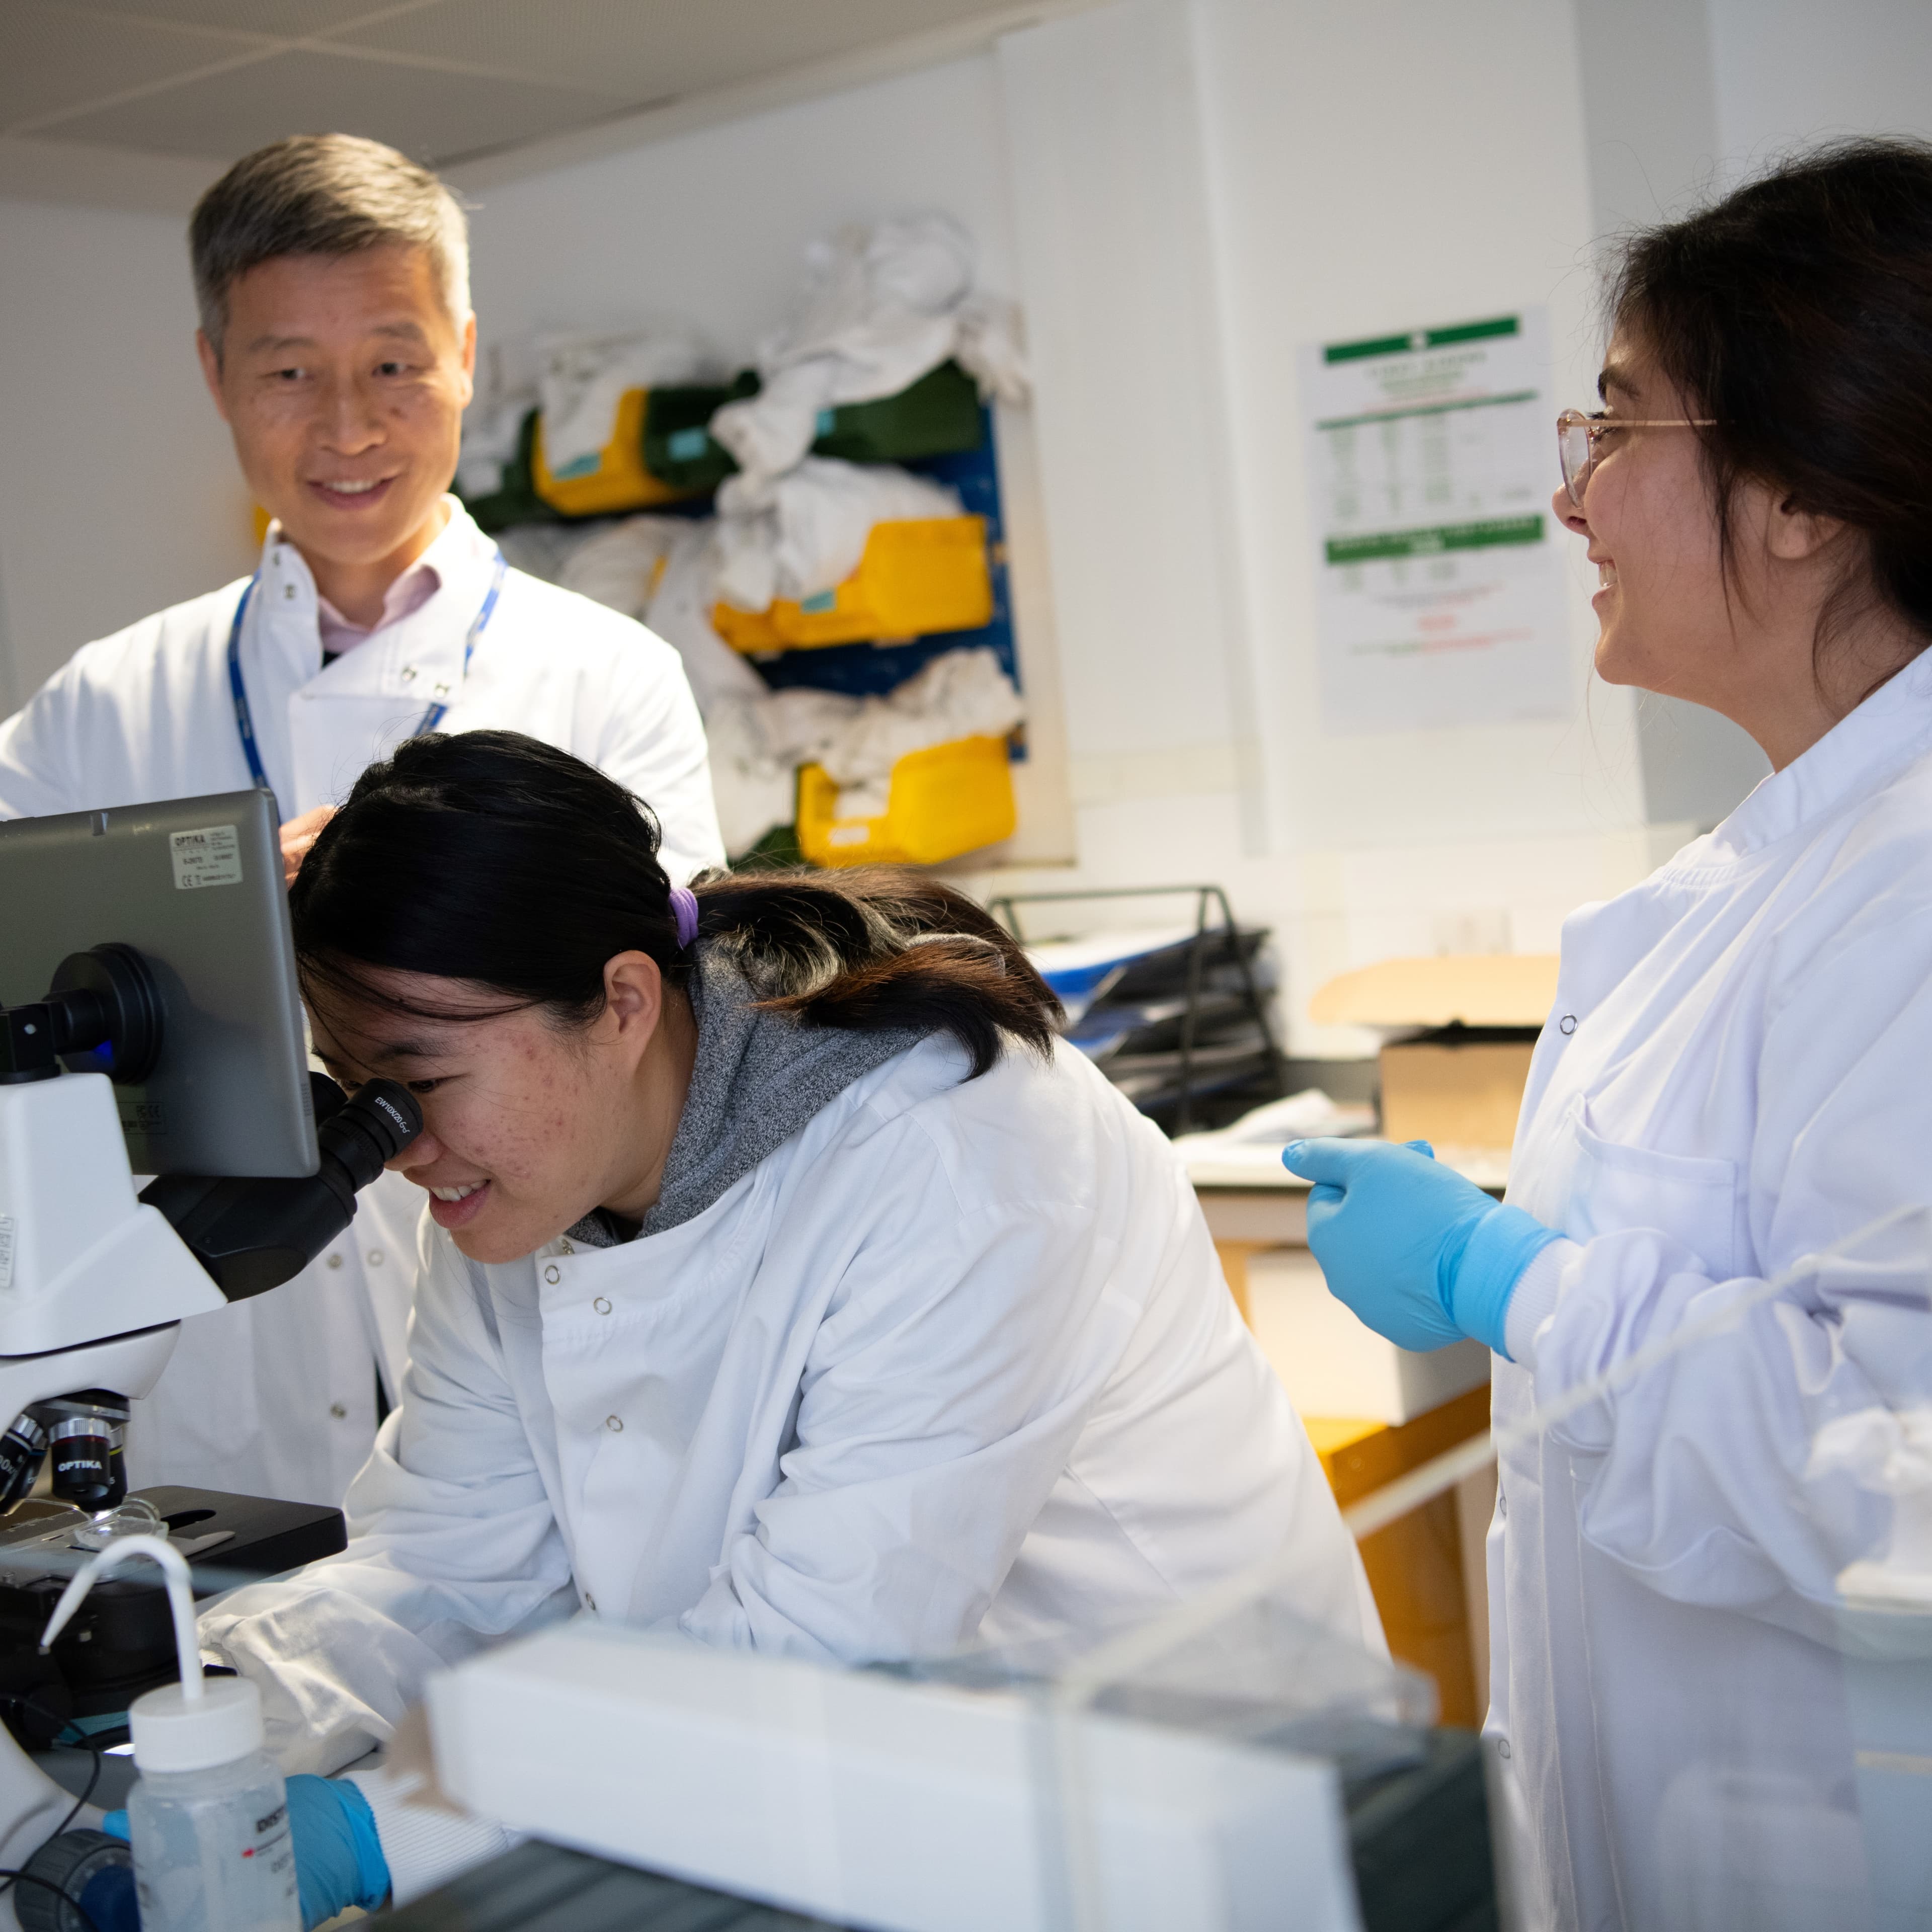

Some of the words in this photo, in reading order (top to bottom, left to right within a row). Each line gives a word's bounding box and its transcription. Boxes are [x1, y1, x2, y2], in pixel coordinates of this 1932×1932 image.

[175, 835, 206, 846] OPTIKA
[374, 1097, 403, 1123] EW10X/20
[58, 1460, 102, 1472] OPTIKA
